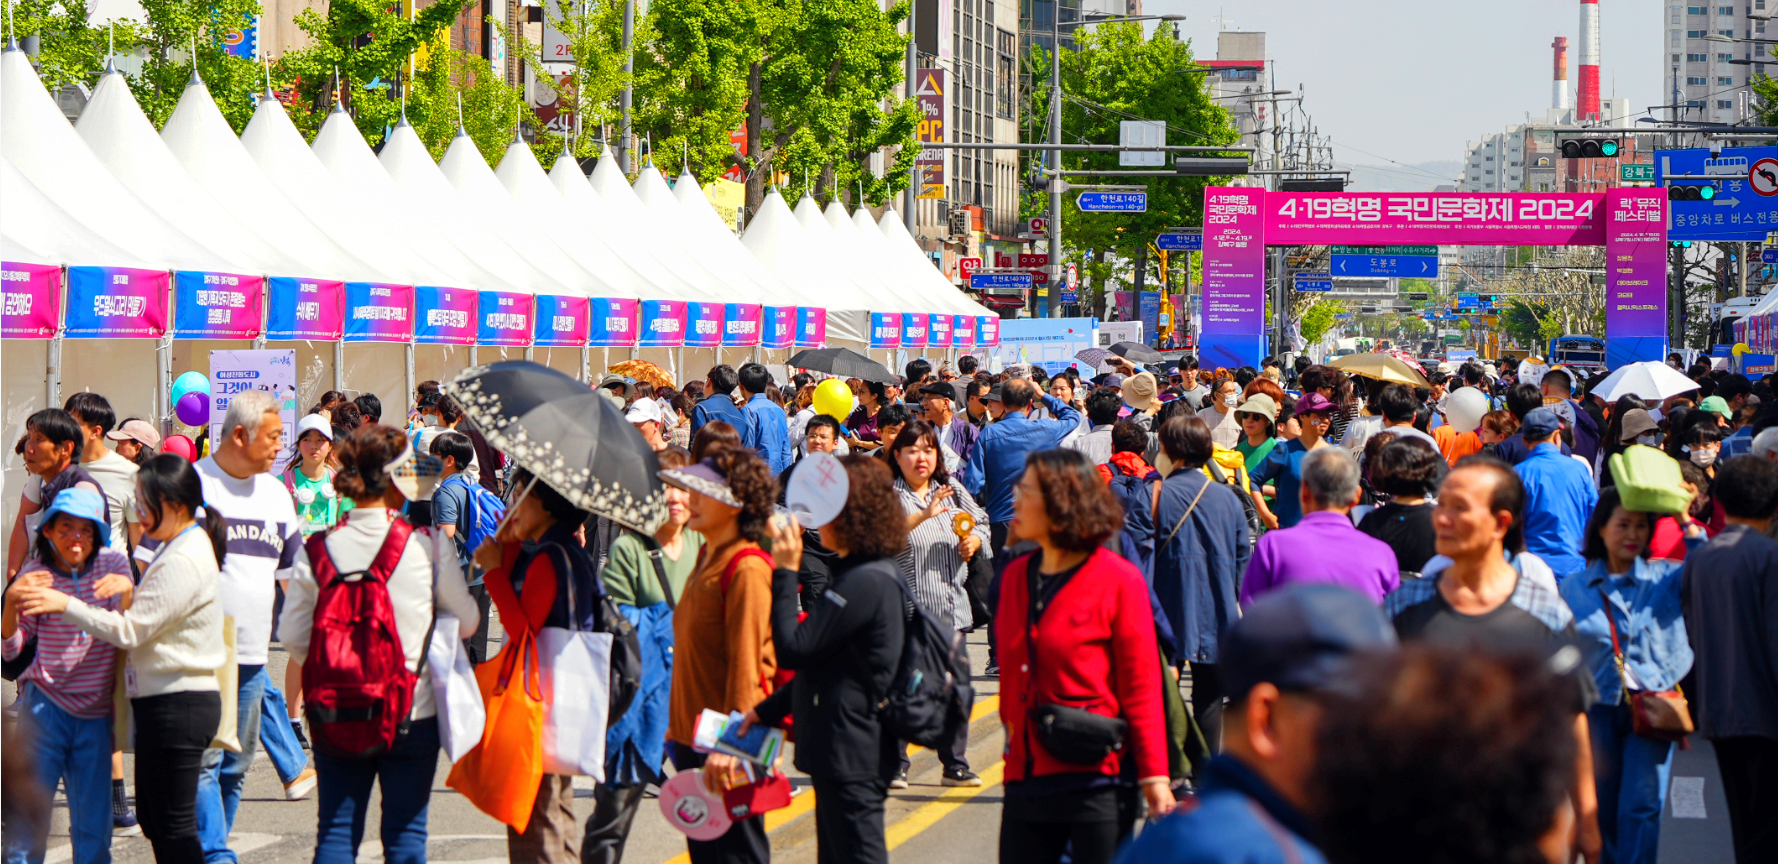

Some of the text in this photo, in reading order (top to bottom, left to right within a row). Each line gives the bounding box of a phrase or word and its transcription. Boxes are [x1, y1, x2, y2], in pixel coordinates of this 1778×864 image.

[920, 99, 938, 116] 1%
[916, 119, 943, 143] PC
[1625, 167, 1654, 178] 강북구
[1100, 194, 1144, 203] 한천로140길
[1208, 205, 1257, 215] 국민문화제
[1387, 197, 1512, 222] 국민문화제
[1519, 199, 1593, 220] 2024
[1614, 210, 1661, 222] 페스티벌
[1209, 215, 1237, 224] 2024
[1675, 210, 1778, 227] 중앙차로 버스전용
[1370, 258, 1397, 268] 도봉로
[1069, 273, 1075, 283] 30
[94, 295, 147, 317] 우드열쇠고리 만들기
[296, 302, 320, 321] 수어 배우기
[216, 381, 253, 395] 그것이
[227, 524, 284, 554] ANDARD
